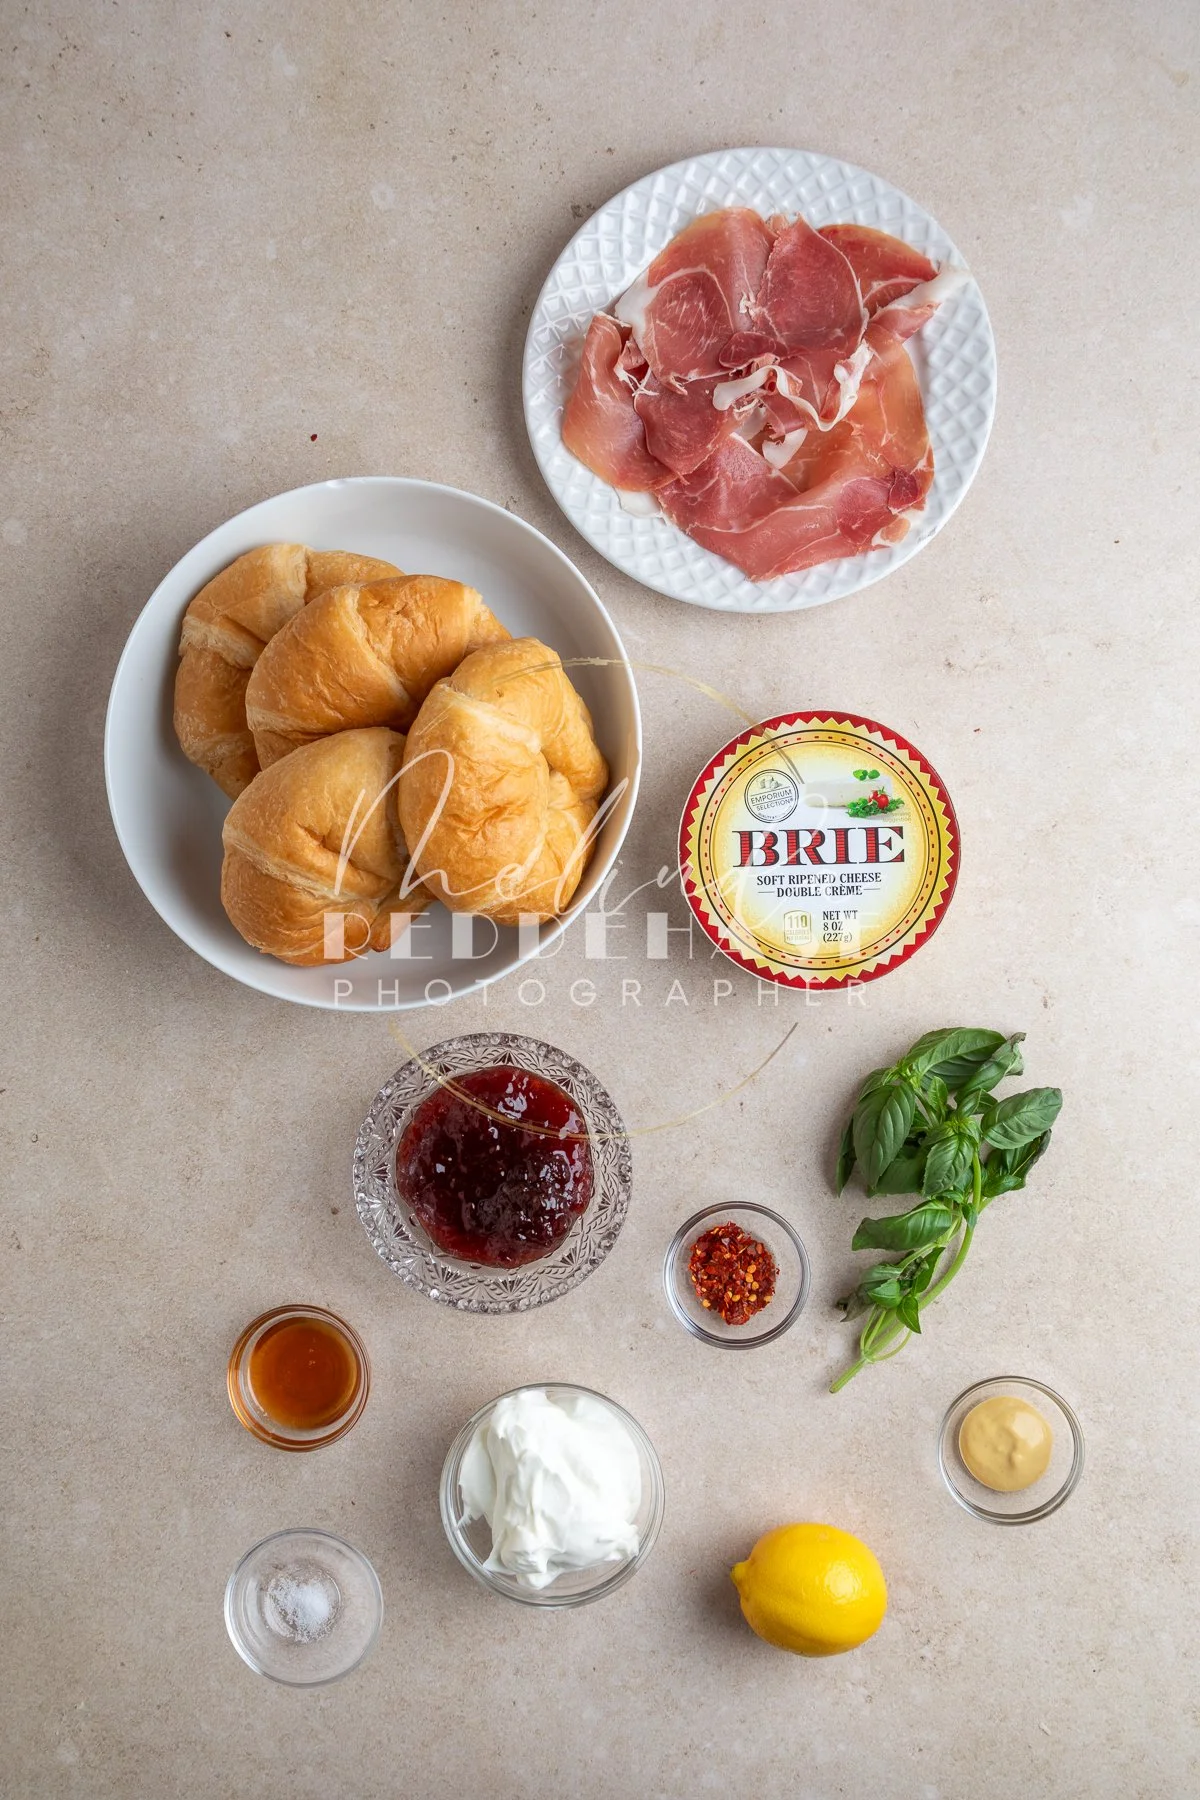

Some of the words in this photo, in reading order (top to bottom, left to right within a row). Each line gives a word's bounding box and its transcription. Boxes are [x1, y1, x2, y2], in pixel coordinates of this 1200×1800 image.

[750, 789, 793, 804] EMPORIUM
[732, 826, 905, 867] BRIE
[756, 875, 785, 886] SOFT
[788, 873, 836, 885] RIPENED
[839, 872, 882, 883] CHEESE
[777, 886, 822, 898] DOUBLE
[824, 884, 863, 897] CRÈME
[788, 914, 808, 928] 110
[822, 911, 841, 920] NET
[843, 910, 858, 919] WT
[823, 922, 829, 931] 8
[831, 921, 844, 931] OZ
[822, 931, 853, 943] (227g)
